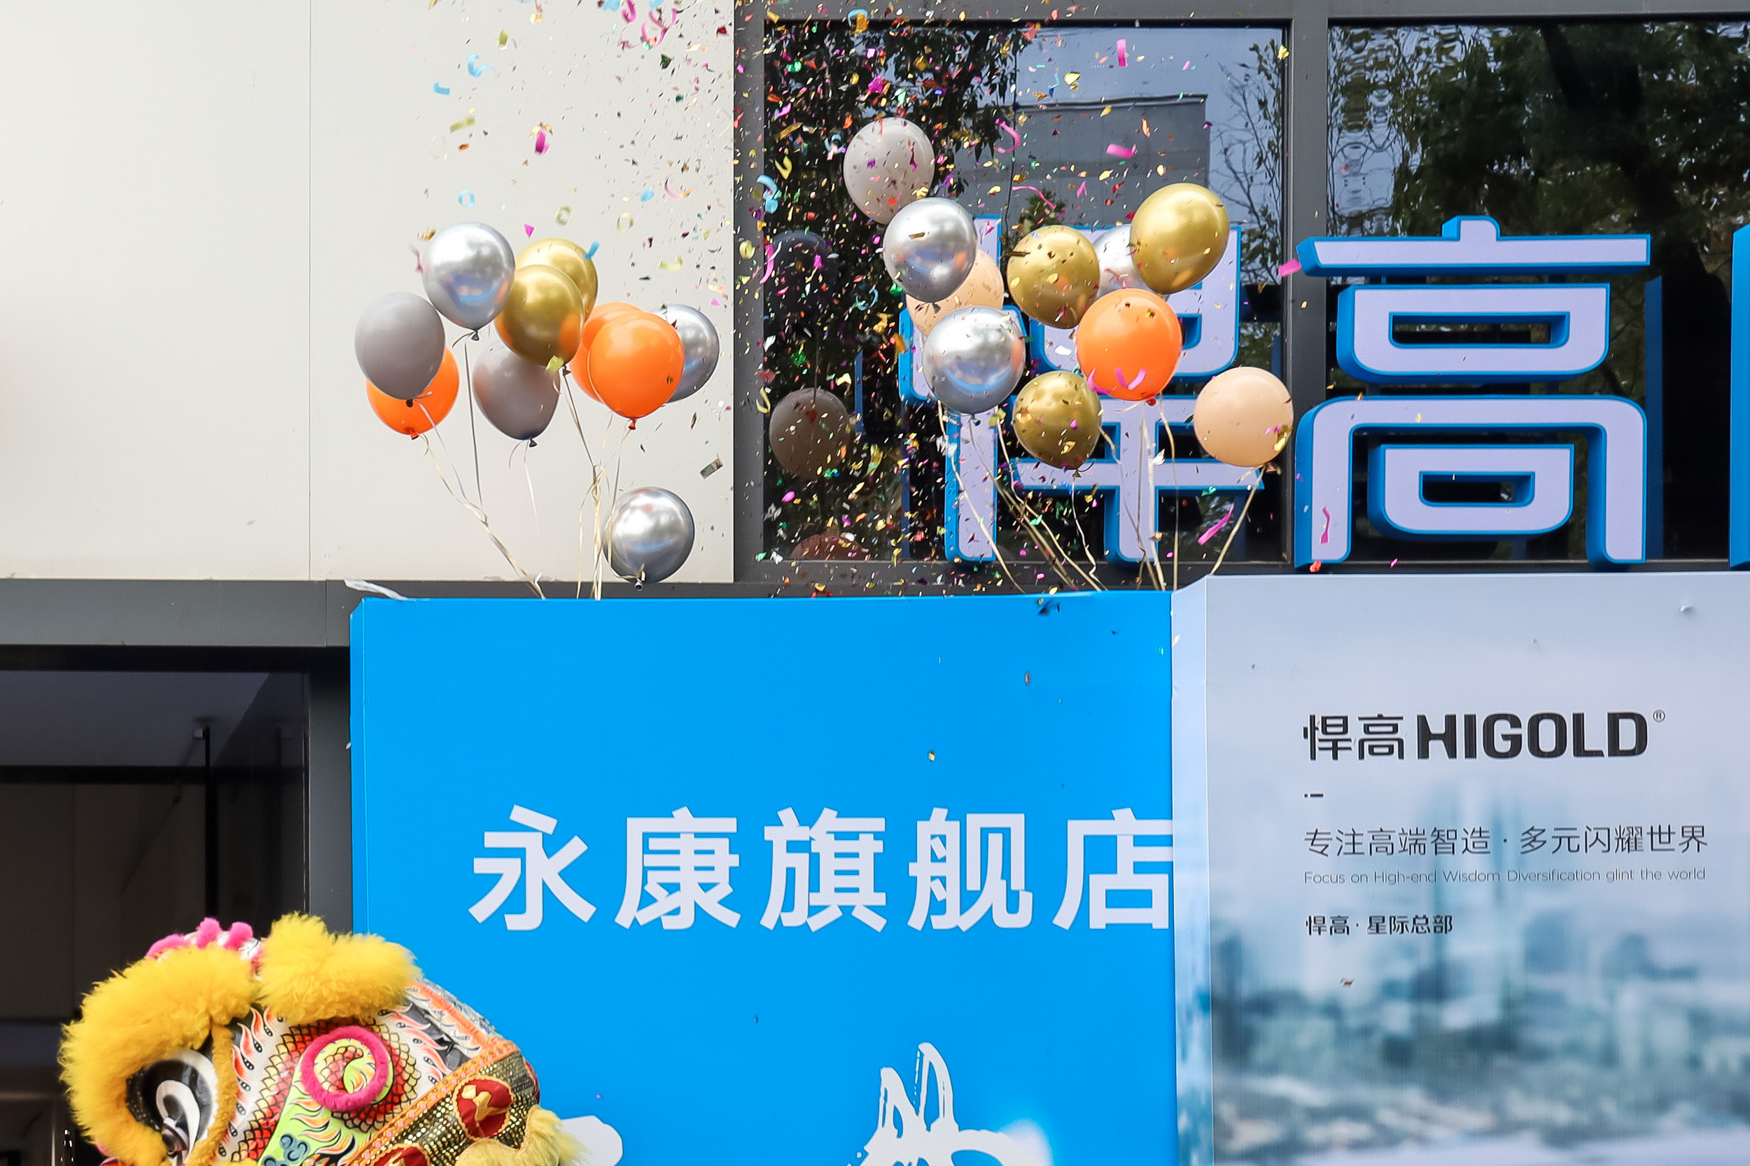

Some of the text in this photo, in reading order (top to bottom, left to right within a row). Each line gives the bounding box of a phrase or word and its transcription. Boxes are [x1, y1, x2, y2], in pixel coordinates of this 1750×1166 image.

[1303, 712, 1648, 761] 悍高 HIGOLD
[469, 804, 1173, 932] 永康旗舰店
[1304, 868, 1706, 886] Focus on High-end Wisdom Diversification glint the world
